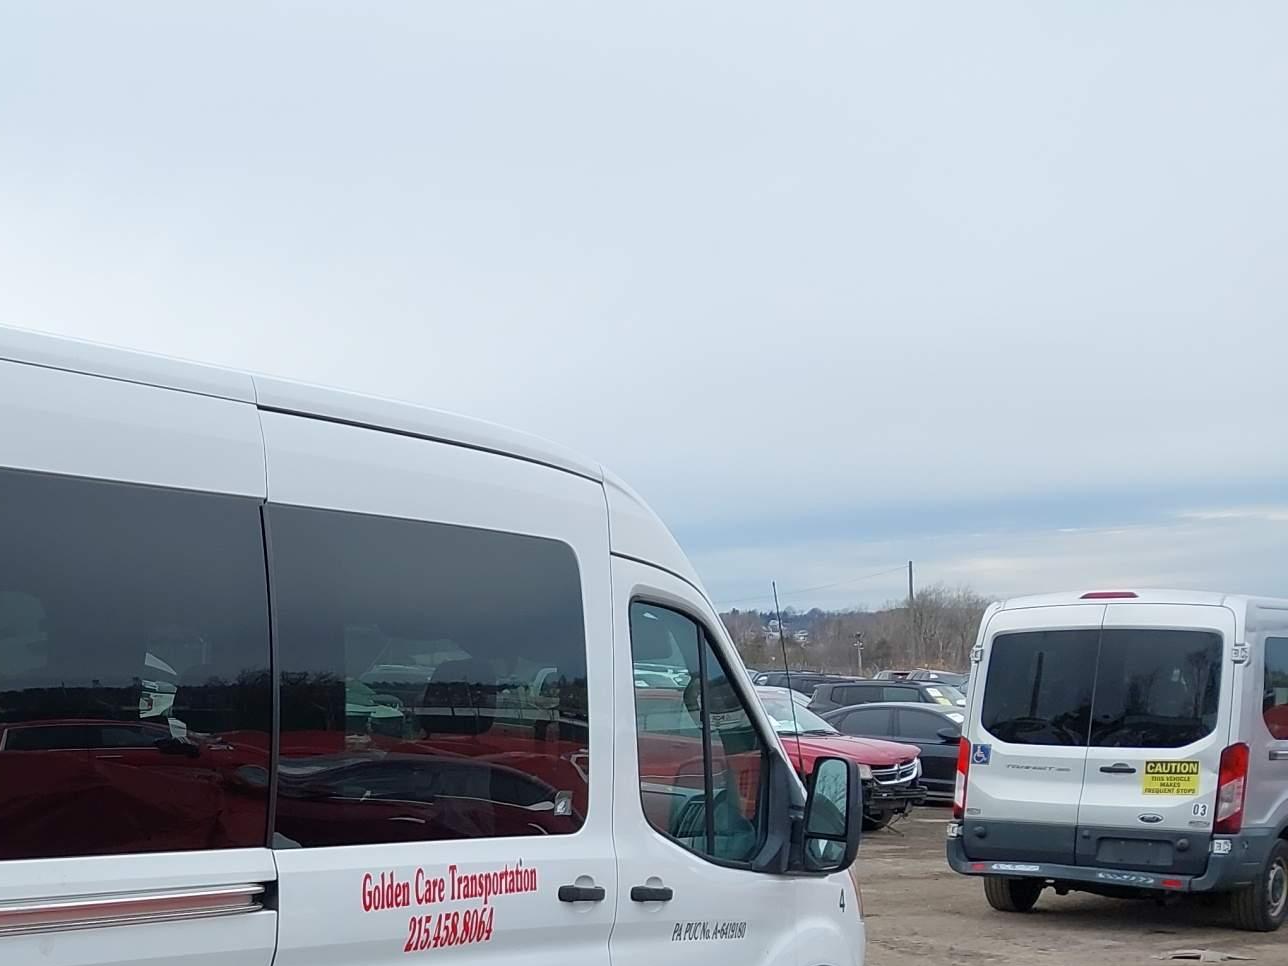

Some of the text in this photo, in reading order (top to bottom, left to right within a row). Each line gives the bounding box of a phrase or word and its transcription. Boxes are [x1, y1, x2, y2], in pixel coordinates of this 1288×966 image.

[1146, 762, 1198, 774] CAUTION
[1192, 803, 1208, 817] 03
[361, 857, 538, 912] Golden Care Transportation
[839, 887, 846, 913] 4
[403, 906, 495, 953] 215.458.8064
[671, 922, 683, 942] PA
